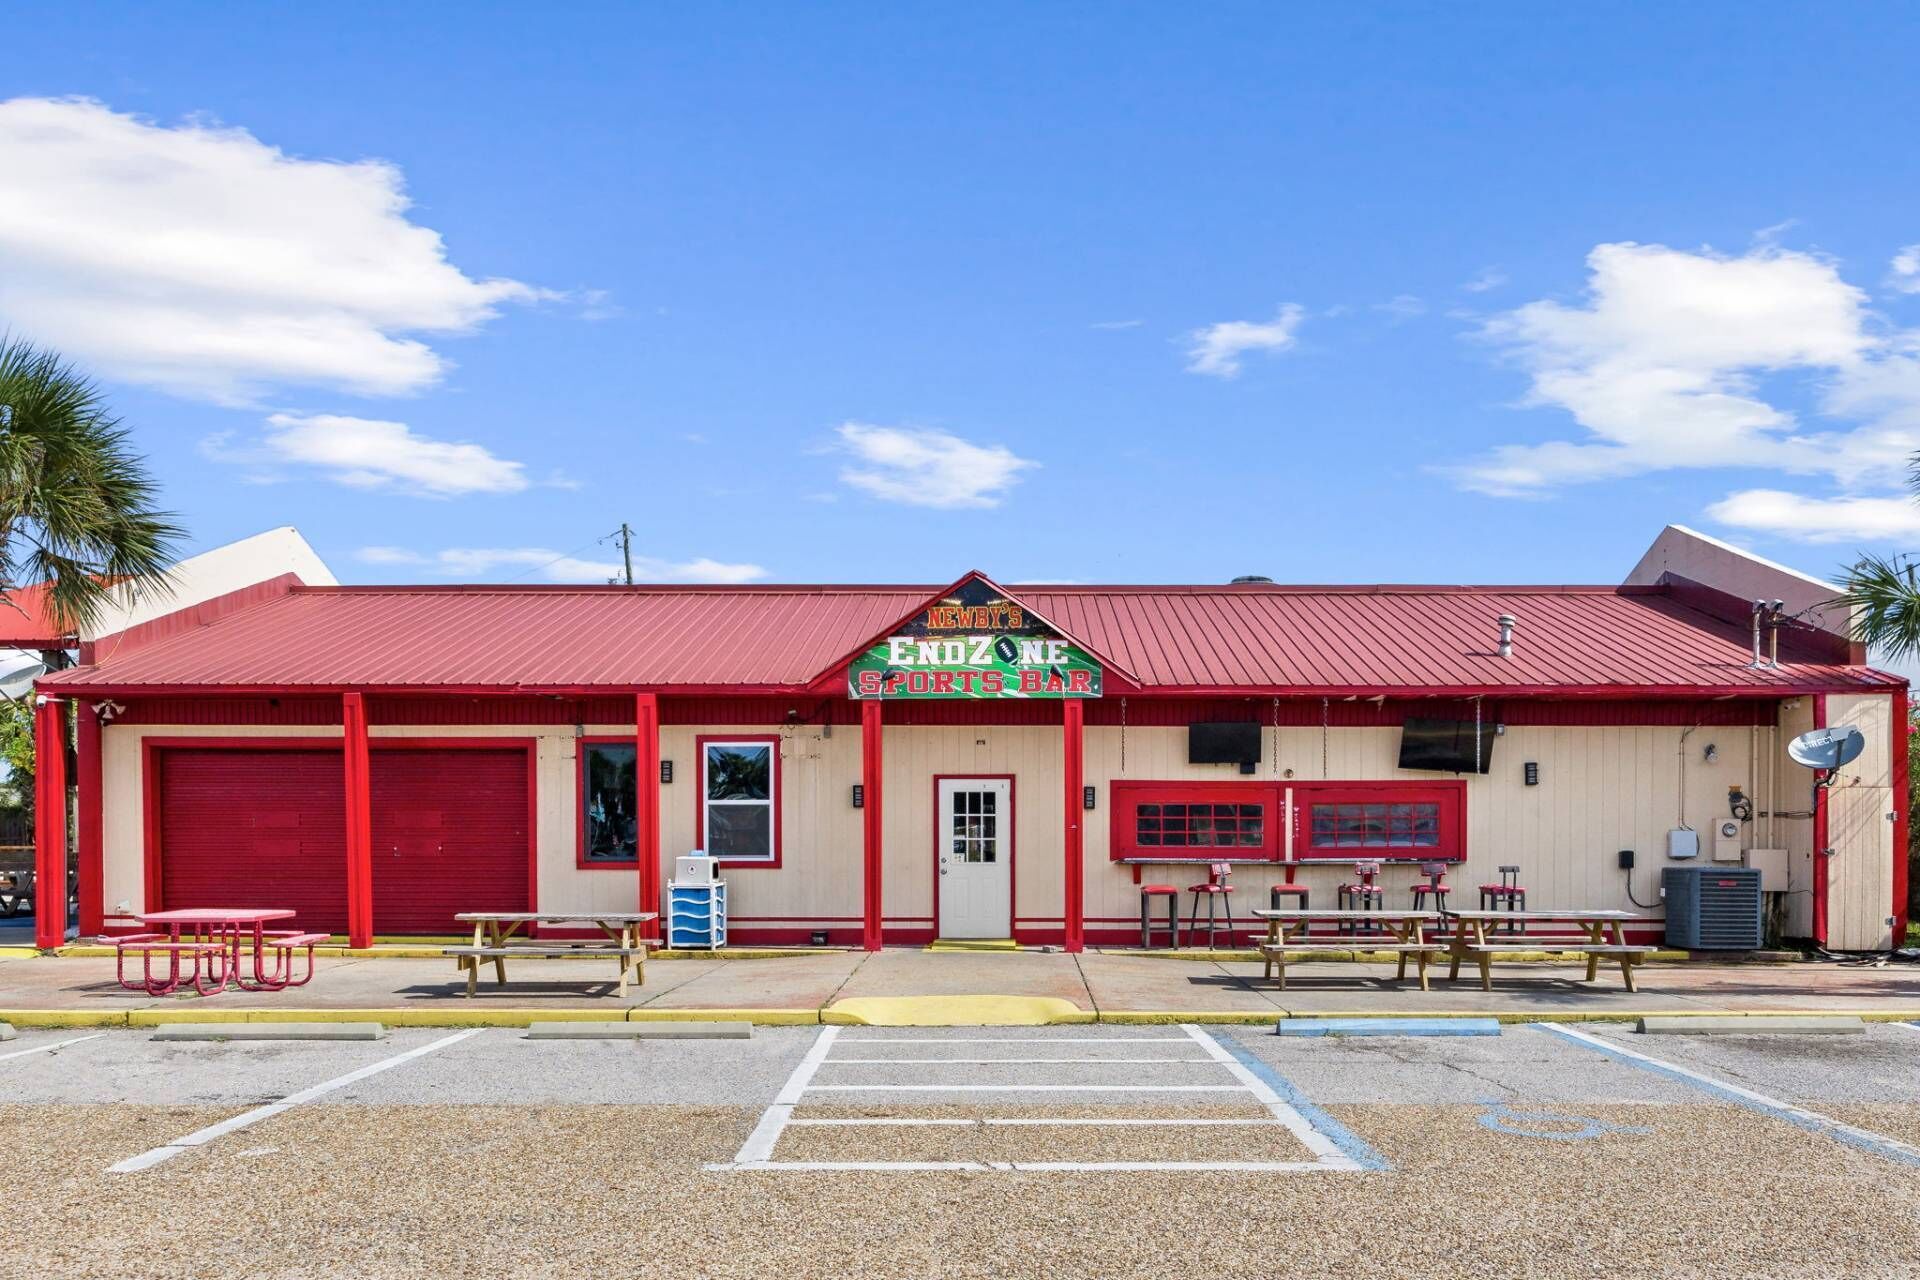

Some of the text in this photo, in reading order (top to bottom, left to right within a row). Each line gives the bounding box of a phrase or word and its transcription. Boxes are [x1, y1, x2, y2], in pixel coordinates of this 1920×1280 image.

[927, 603, 1022, 629] NEWBY'S
[859, 670, 1092, 695] SPORTS BAR
